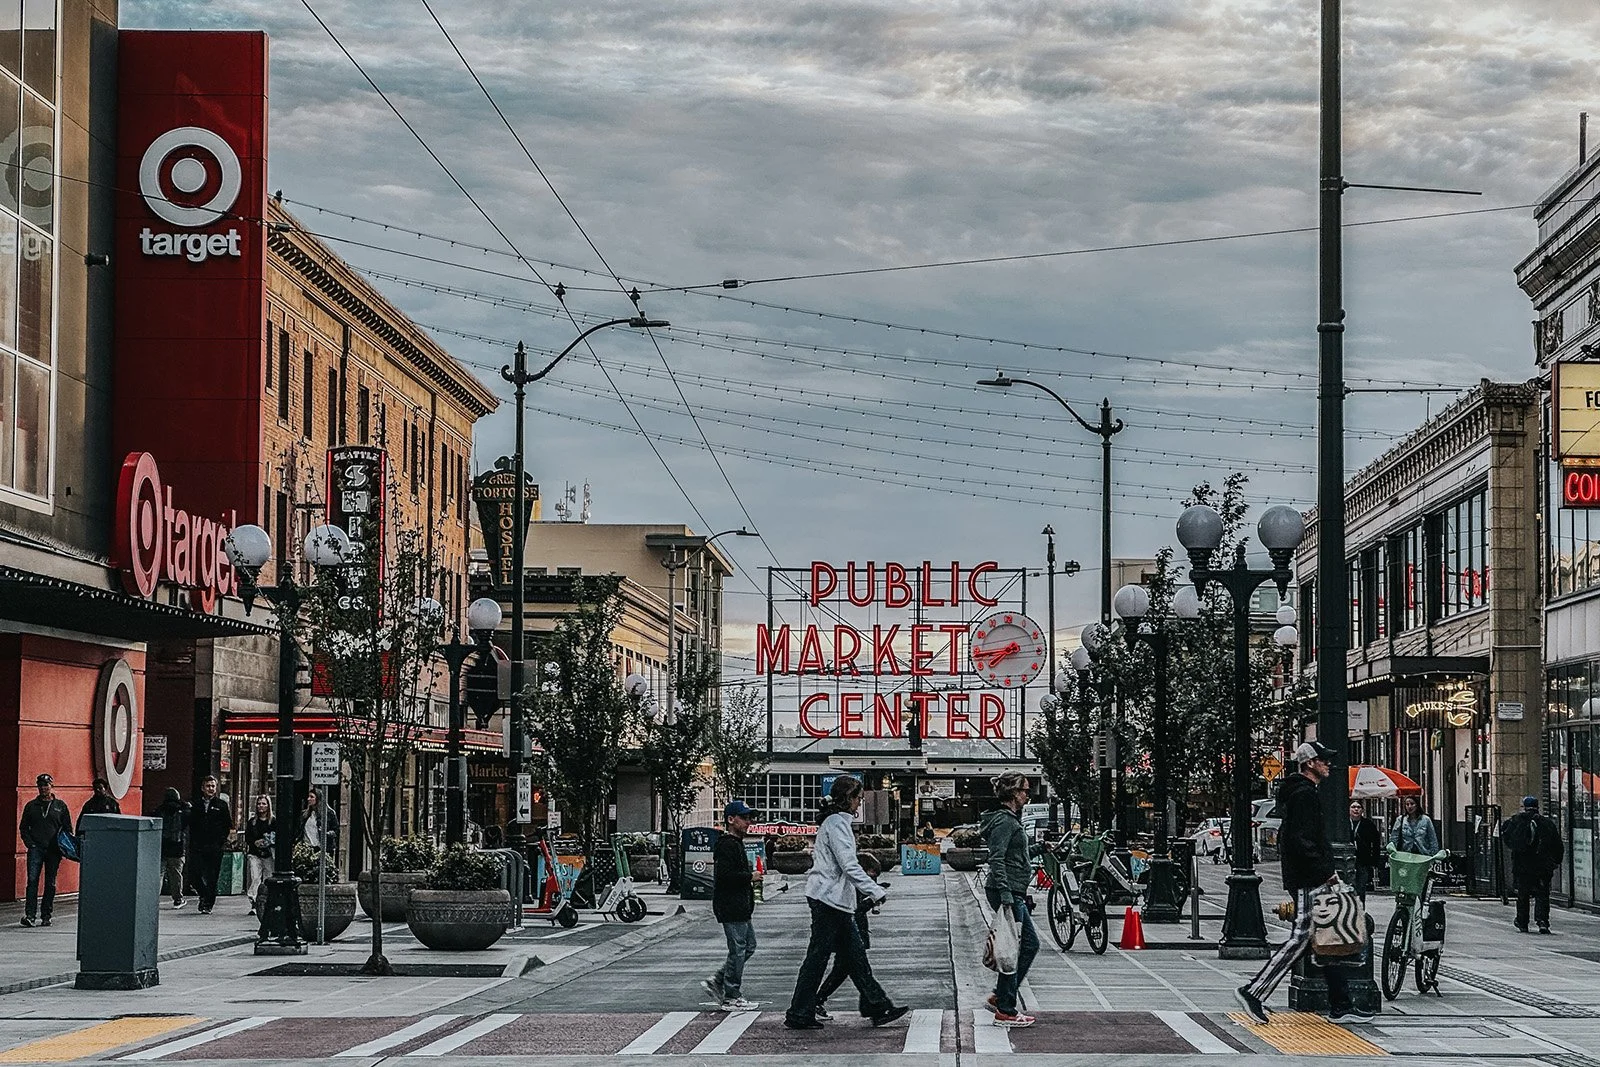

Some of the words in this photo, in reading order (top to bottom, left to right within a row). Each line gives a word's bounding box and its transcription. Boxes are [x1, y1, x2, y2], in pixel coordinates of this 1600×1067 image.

[139, 227, 241, 262] target
[333, 450, 380, 461] SEATTLE
[488, 472, 516, 485] GREE
[474, 487, 538, 499] TORTOSE
[499, 502, 514, 585] HOSTEL
[811, 561, 998, 608] PUBLIC
[756, 624, 970, 676] MARKET
[1418, 701, 1453, 712] LUKE'S
[800, 692, 1006, 739] CENTER
[469, 763, 509, 777] Market
[519, 777, 529, 789] ONE
[519, 791, 529, 802] WAY
[748, 825, 779, 834] MARKET
[781, 825, 817, 834] THEATER
[688, 844, 711, 853] Recycle
